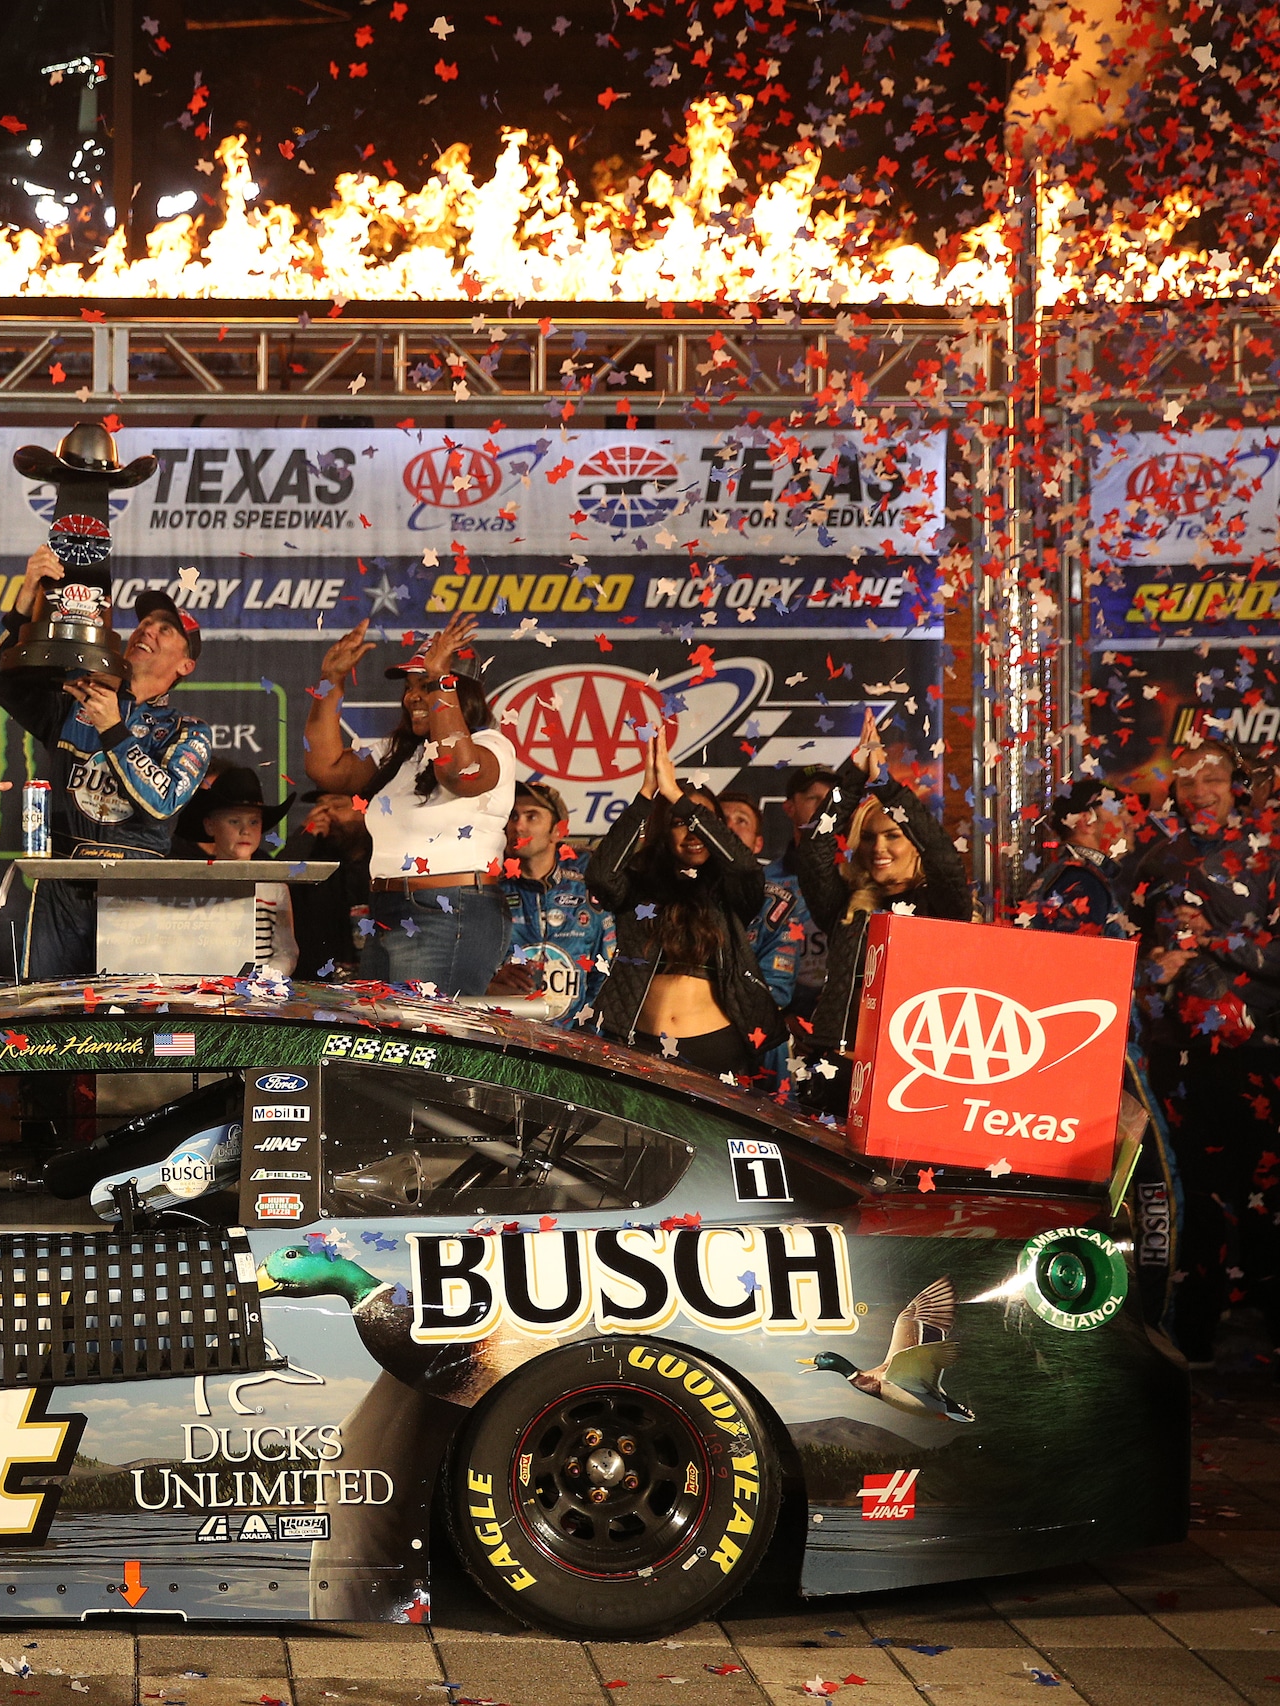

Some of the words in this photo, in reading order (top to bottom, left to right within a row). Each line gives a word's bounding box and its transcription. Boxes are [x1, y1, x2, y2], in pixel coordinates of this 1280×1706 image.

[152, 447, 356, 505] TEXAS
[409, 447, 496, 507] AAA
[700, 447, 907, 503] TEXAS
[150, 509, 227, 529] MOTOR
[233, 509, 348, 529] SPEEDWAY
[450, 513, 517, 532] Texas
[243, 578, 345, 610] LANE
[425, 574, 635, 612] SUNOCO
[645, 577, 804, 609] VICTORY
[70, 766, 118, 795] BUS
[127, 745, 171, 798] BUSCH
[60, 1036, 140, 1056] Harvick
[900, 989, 1034, 1081] AAA
[265, 1075, 298, 1090] Ford
[254, 1108, 290, 1119] Mobil
[294, 1108, 305, 1119] 1
[963, 1098, 1080, 1143] Texas
[254, 1137, 308, 1152] HAAS
[730, 1141, 779, 1155] Mobil
[161, 1165, 216, 1182] BUSCH
[747, 1160, 768, 1197] 1
[267, 1208, 291, 1216] PIZZA
[1139, 1182, 1170, 1265] BUSCH
[1026, 1227, 1122, 1259] AMERICAN
[412, 1225, 854, 1337] BUSCH
[1036, 1294, 1124, 1328] ETHANOL
[181, 1423, 344, 1463] DUCKS
[131, 1470, 394, 1510] UNLIMITED
[689, 1468, 698, 1493] AERO
[285, 1518, 323, 1528] RUSH
[862, 1504, 915, 1519] HAAS
[468, 1469, 538, 1592] EAGLE
